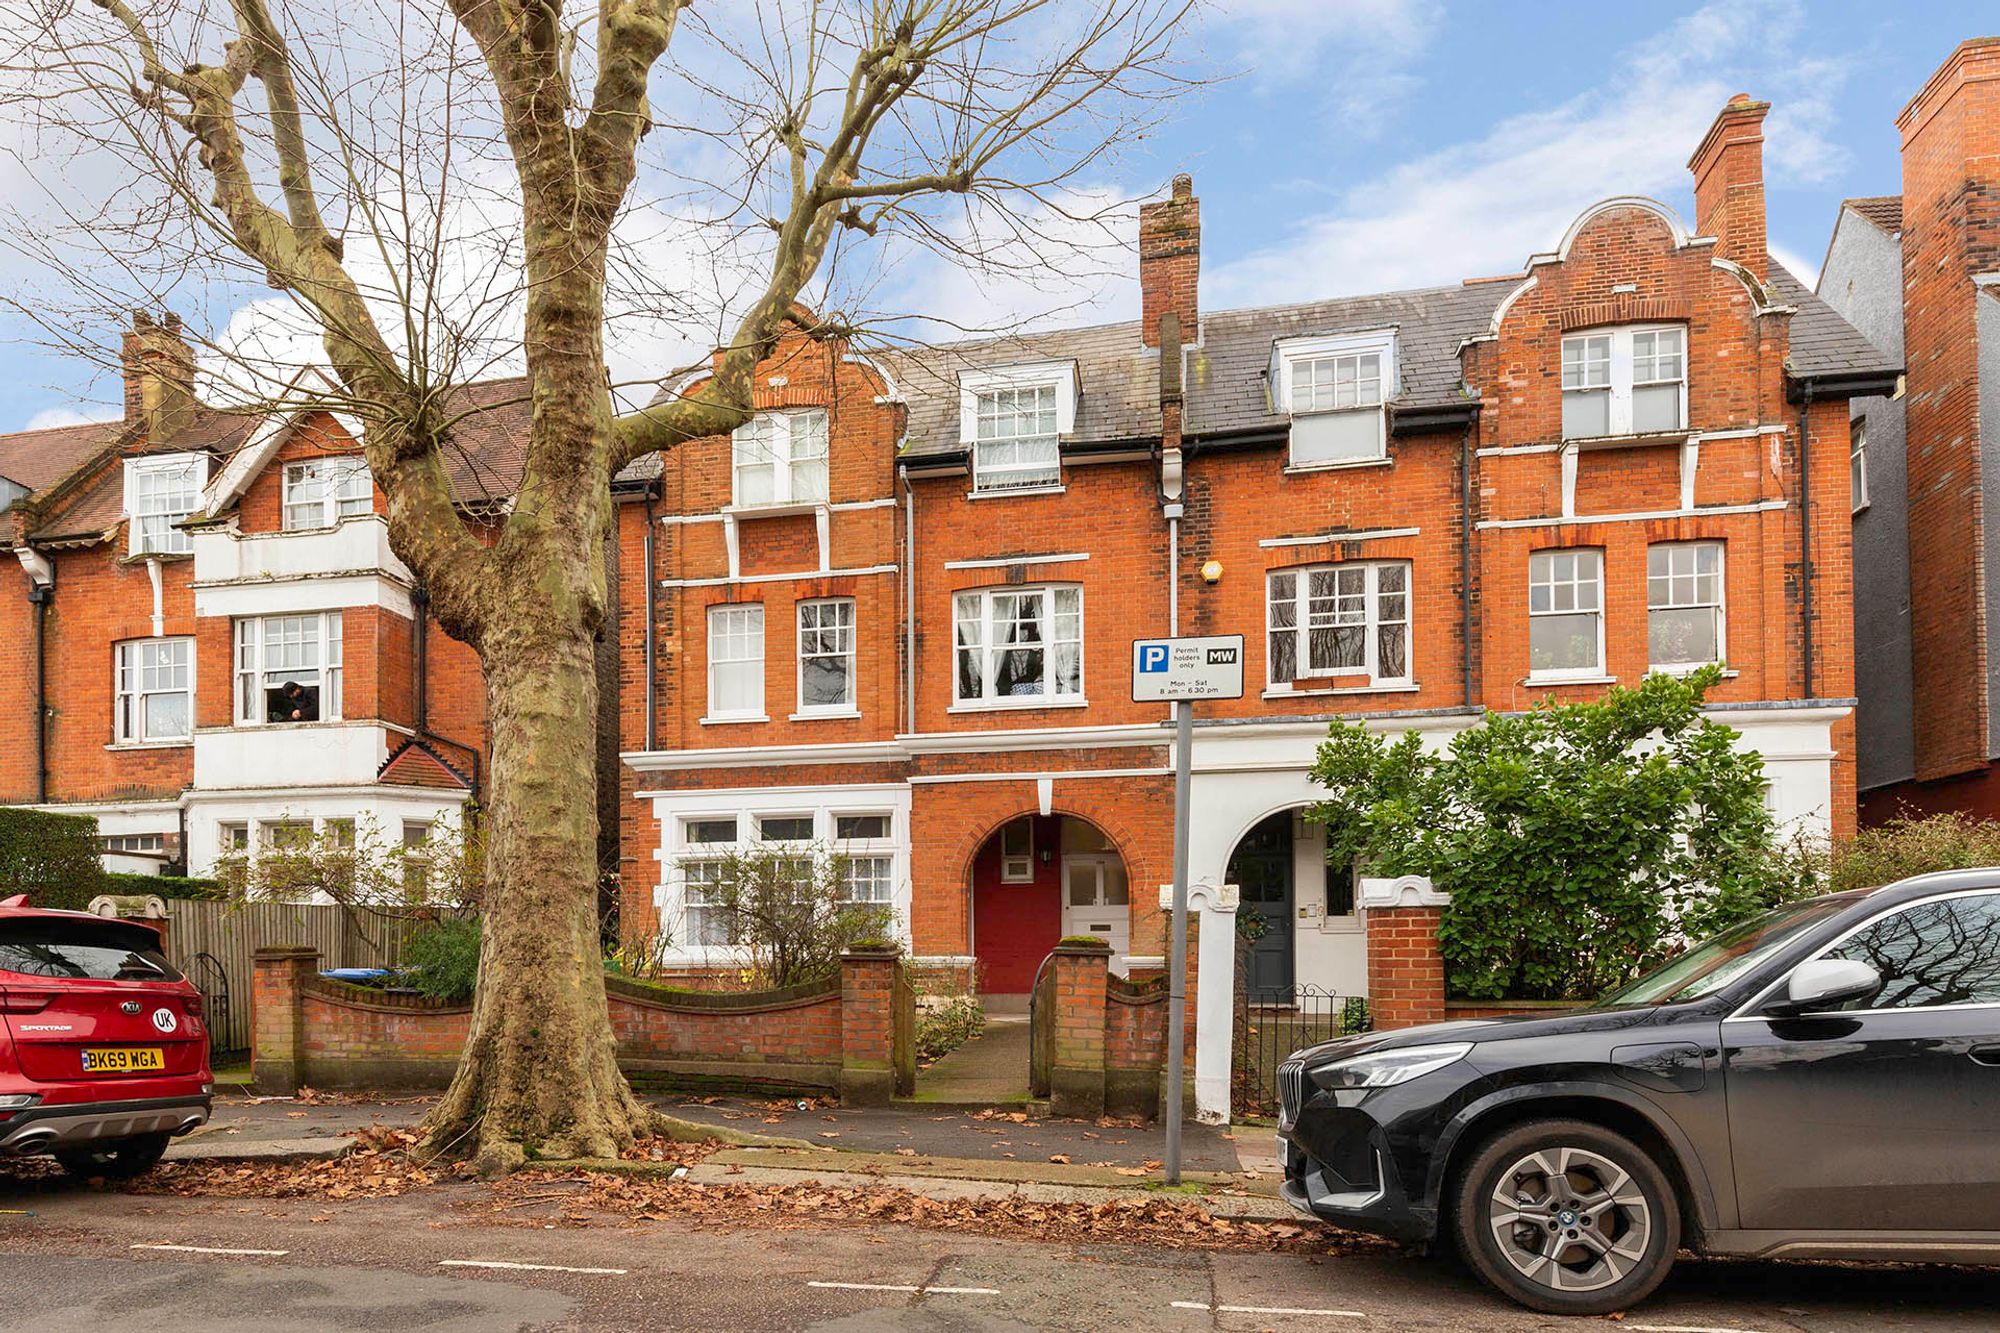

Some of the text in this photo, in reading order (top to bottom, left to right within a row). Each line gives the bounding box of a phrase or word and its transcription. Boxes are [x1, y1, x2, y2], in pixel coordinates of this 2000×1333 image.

[1146, 648, 1164, 671] P
[1209, 650, 1234, 662] MW
[156, 1012, 174, 1028] UK
[89, 1051, 158, 1069] BK69 WGA
